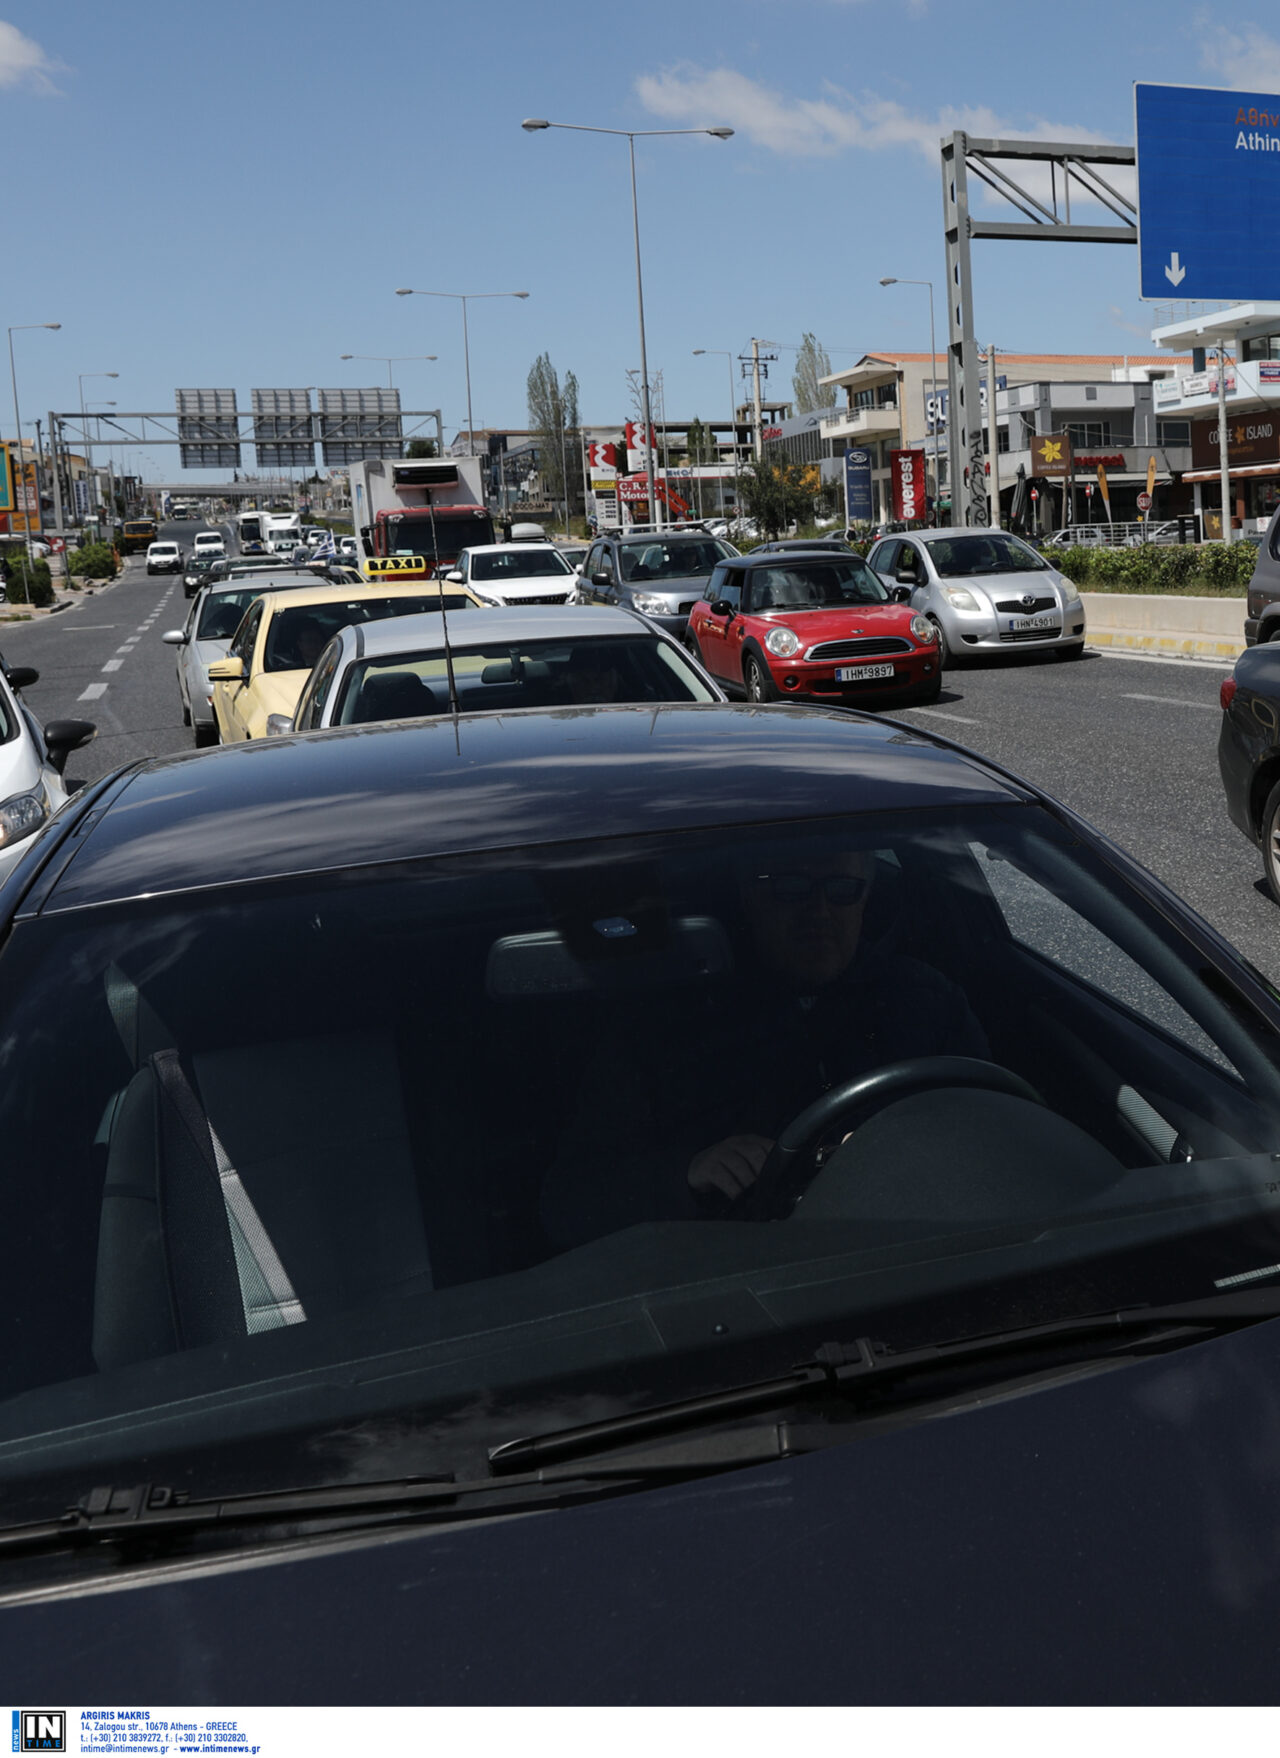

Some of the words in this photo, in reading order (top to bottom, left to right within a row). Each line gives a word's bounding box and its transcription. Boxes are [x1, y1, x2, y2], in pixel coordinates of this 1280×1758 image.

[1246, 424, 1273, 440] ISLAND
[898, 455, 915, 518] everest
[374, 559, 416, 570] TAXI
